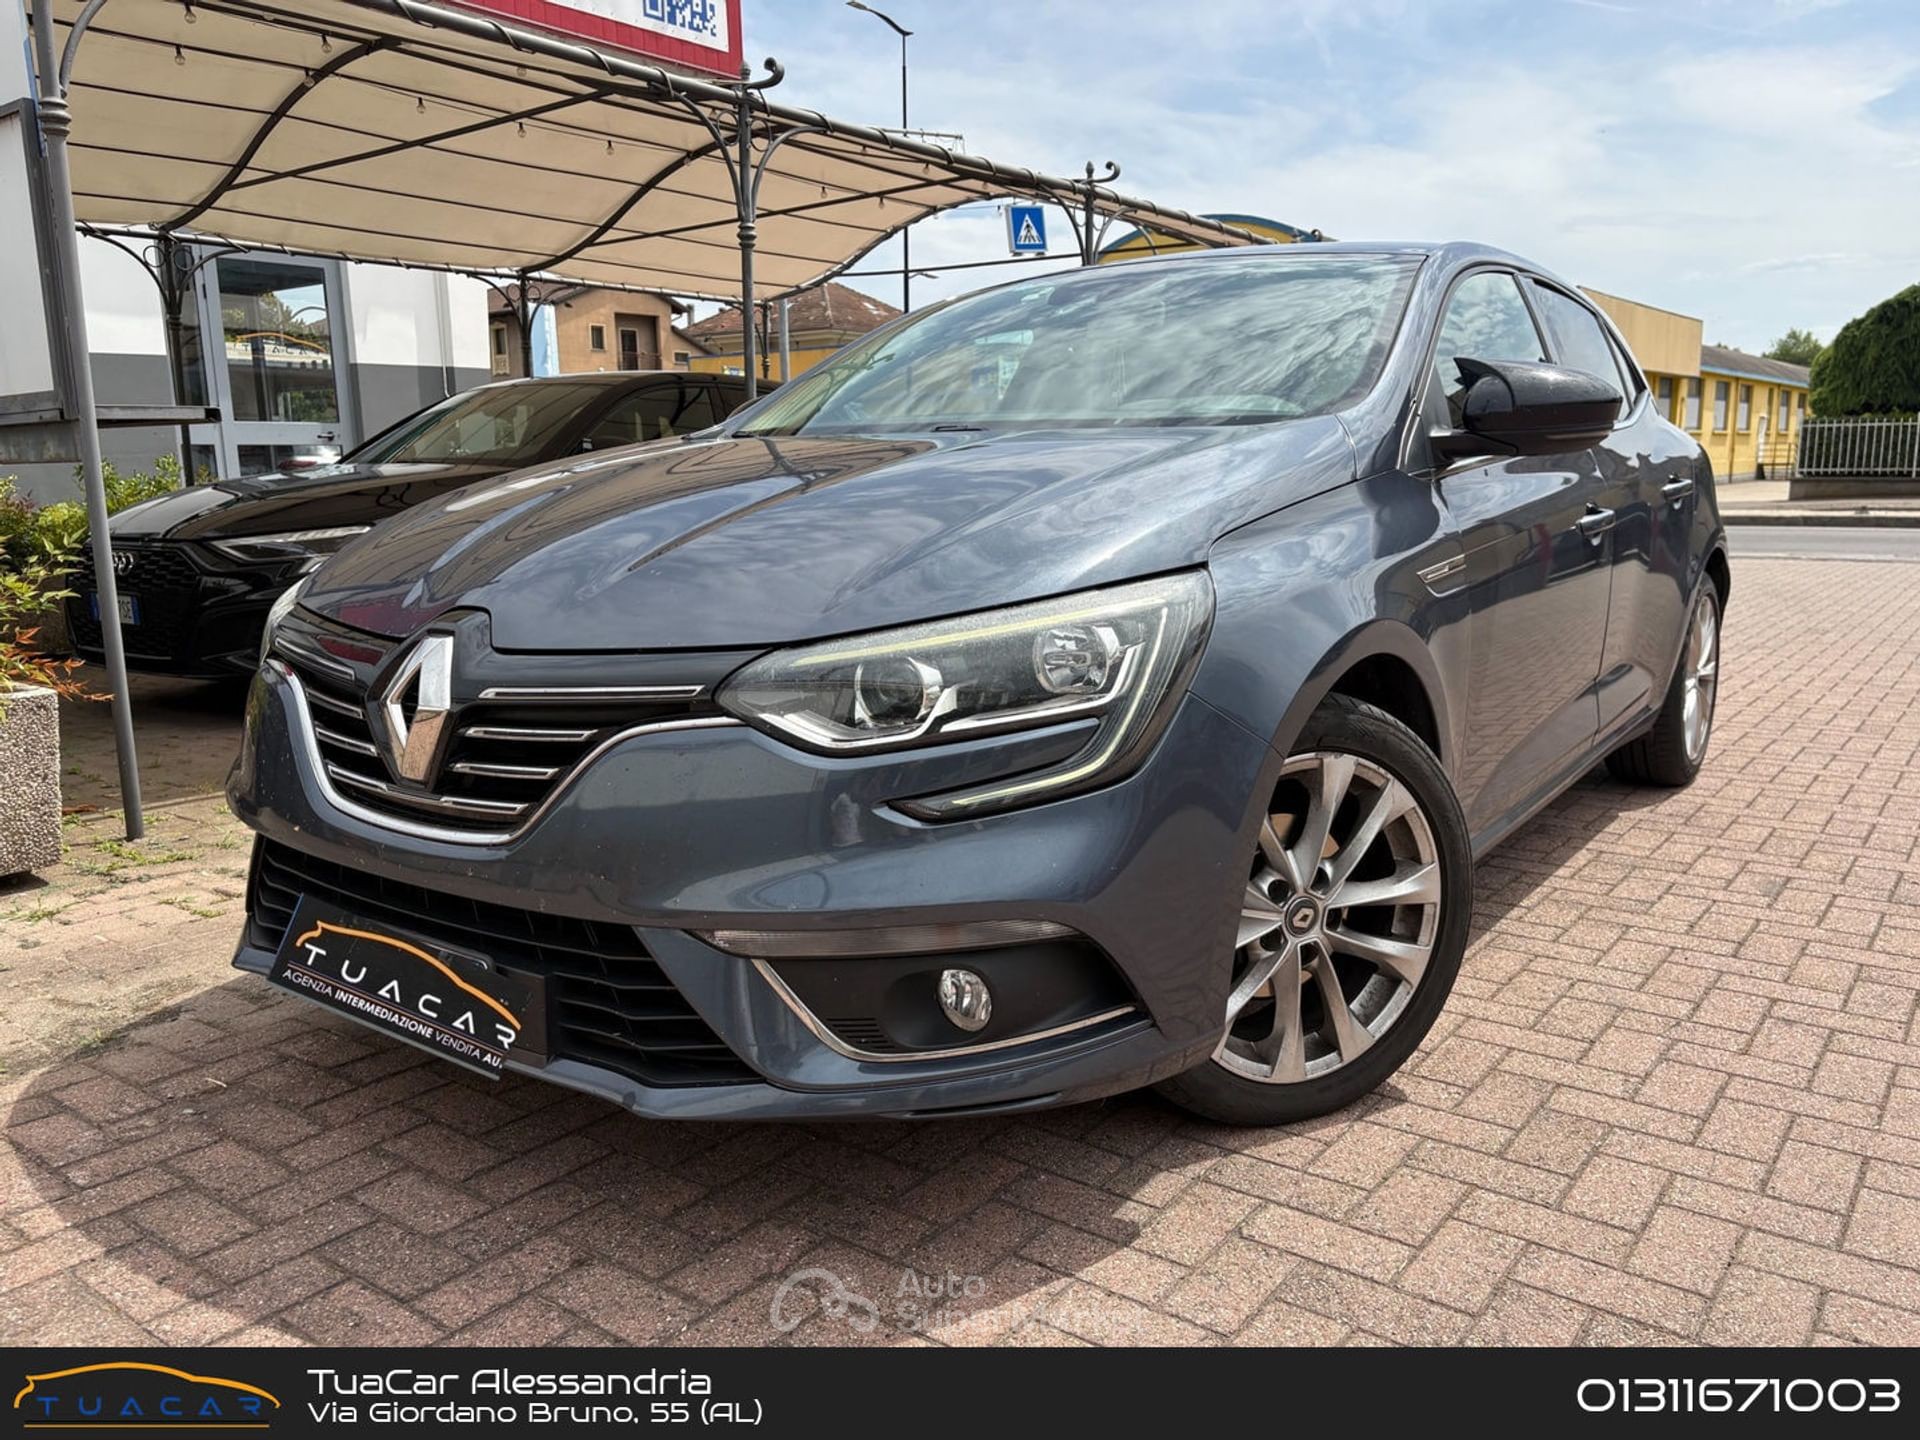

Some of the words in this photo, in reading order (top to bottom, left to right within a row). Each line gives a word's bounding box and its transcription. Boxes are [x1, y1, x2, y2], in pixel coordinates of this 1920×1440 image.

[282, 969, 333, 996] AGENZIA
[334, 990, 433, 1038] INTERMEDIAZIONE
[435, 1032, 481, 1060] VENDITA
[304, 943, 517, 1050] TUACAR
